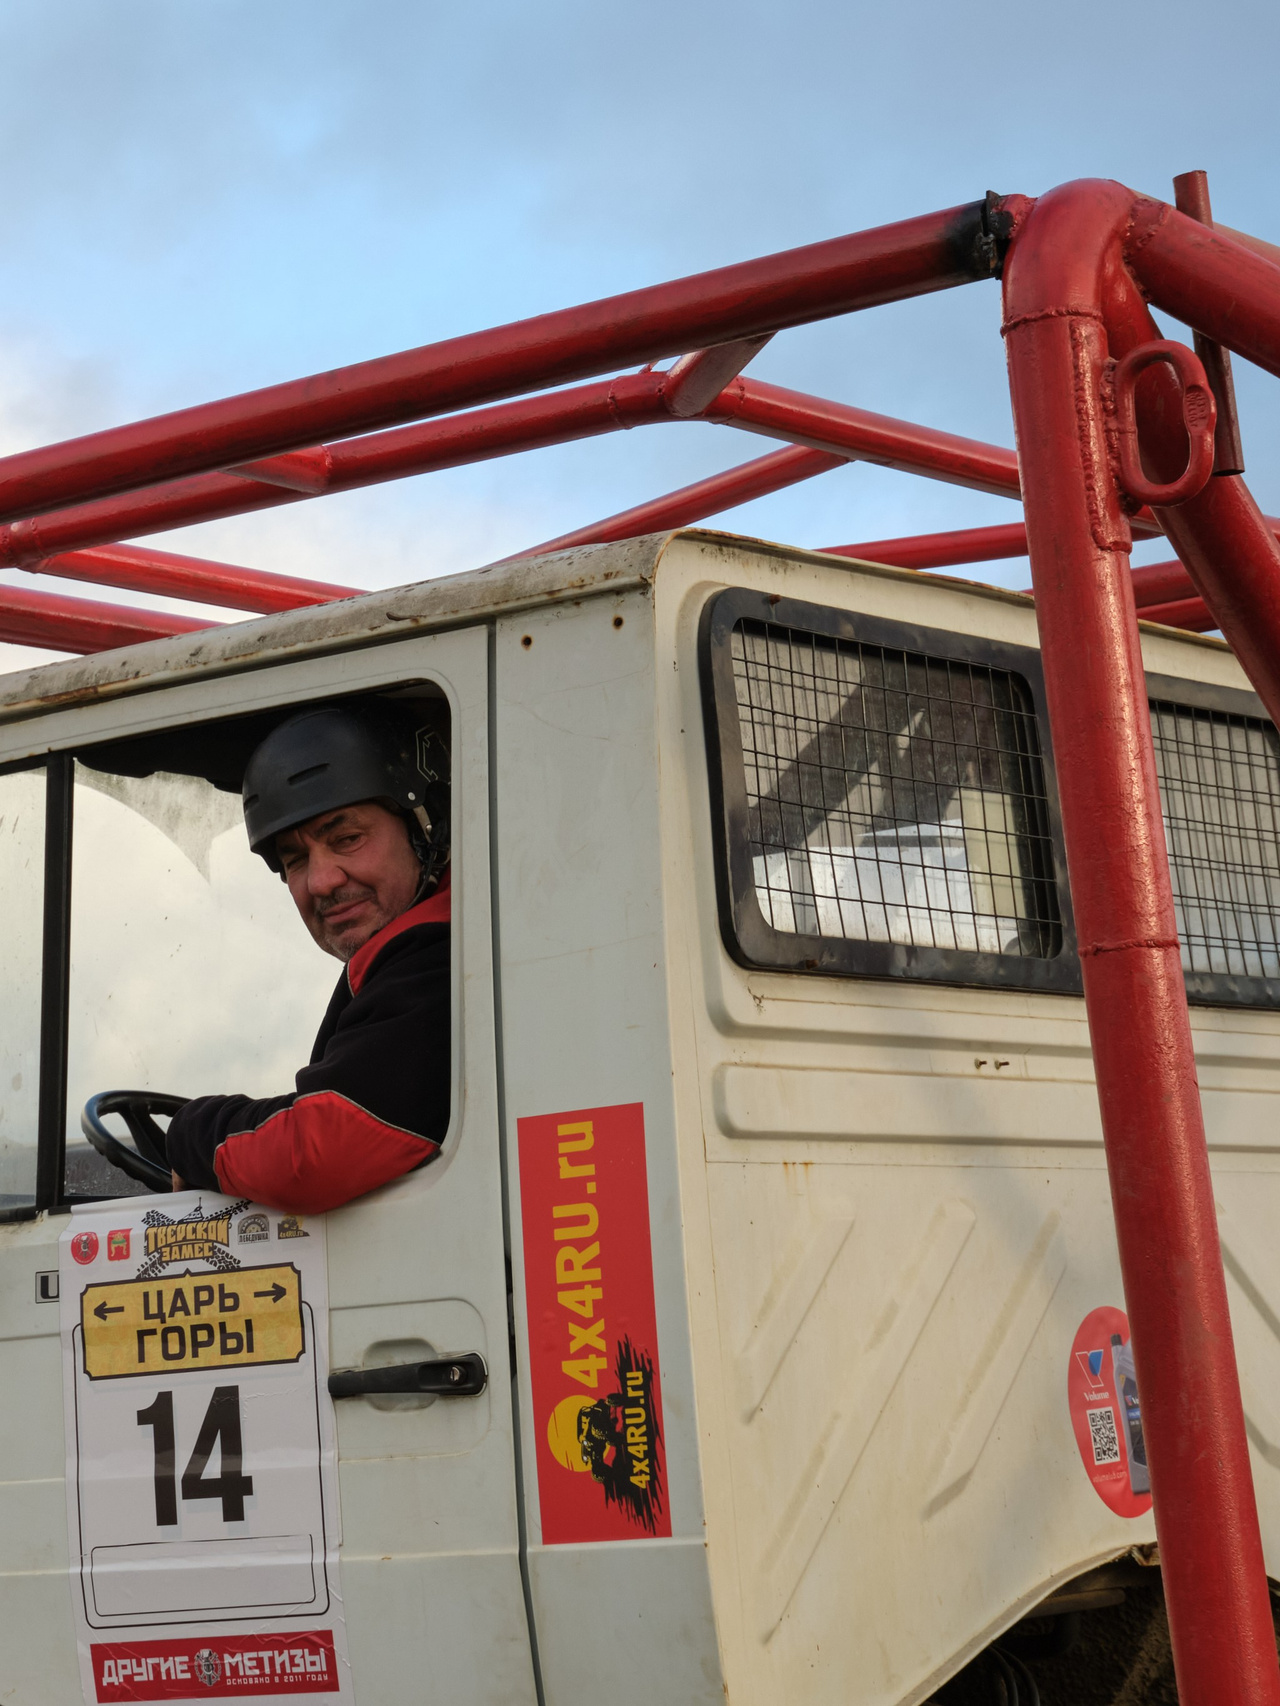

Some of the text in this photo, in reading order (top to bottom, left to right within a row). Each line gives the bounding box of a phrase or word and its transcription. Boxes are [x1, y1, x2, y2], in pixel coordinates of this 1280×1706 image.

[161, 1242, 214, 1262] ЗАМЕС
[552, 1120, 608, 1389] 4x4RU.ru
[142, 1282, 240, 1324] ЦАРЬ
[136, 1318, 254, 1363] ГОРЫ
[1083, 1391, 1110, 1402] Volume
[626, 1370, 650, 1490] 4x4RU.ru
[136, 1385, 254, 1526] 14
[102, 1648, 328, 1687] ДРУГИЕ МЕТИЗЫ
[226, 1676, 271, 1686] ОСНОВАНО
[283, 1674, 303, 1683] 2011
[306, 1673, 329, 1682] ГОДУ
